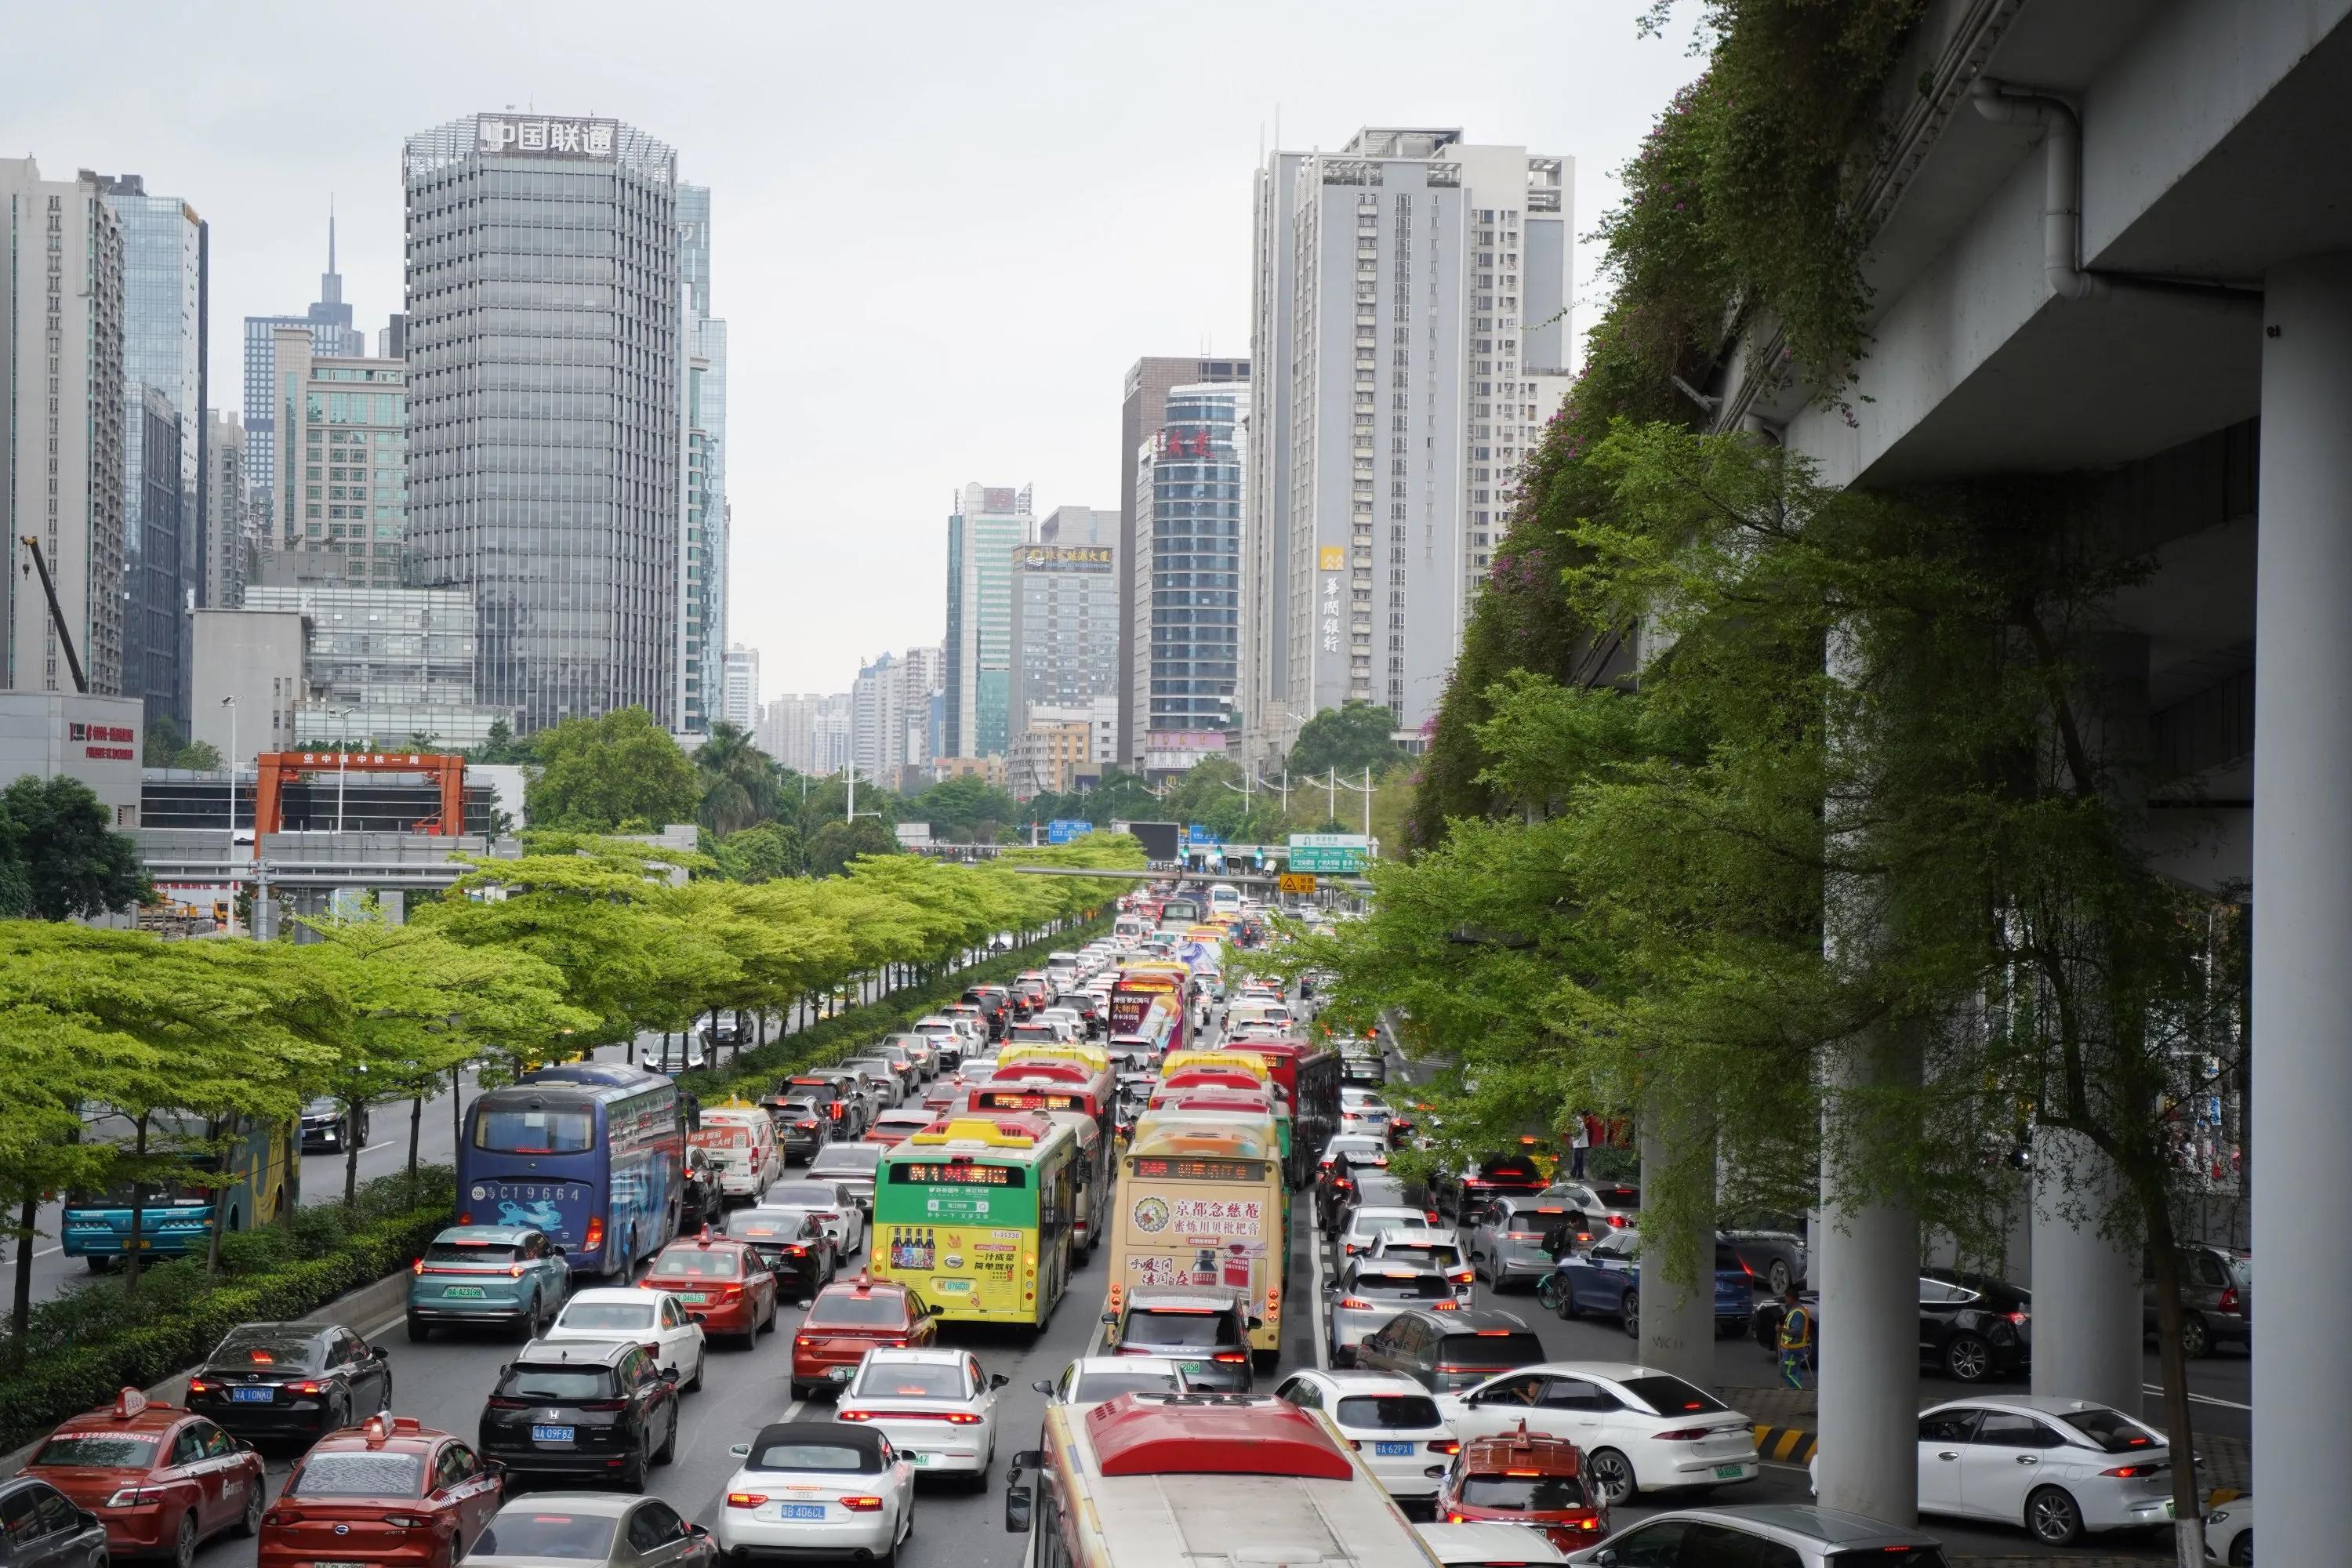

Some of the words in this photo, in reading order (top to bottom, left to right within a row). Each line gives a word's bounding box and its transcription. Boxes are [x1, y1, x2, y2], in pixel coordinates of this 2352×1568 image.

[480, 120, 613, 155] 中国联通
[1323, 577, 1340, 653] 華潤銀行
[321, 754, 419, 764] 中国中铁一局
[1174, 1219, 1259, 1236] 蜜炼川贝枇杷膏
[975, 1262, 1014, 1271] 简单驾驭
[1130, 1258, 1173, 1273] 呼吸之间
[796, 1506, 824, 1518] 406CL
